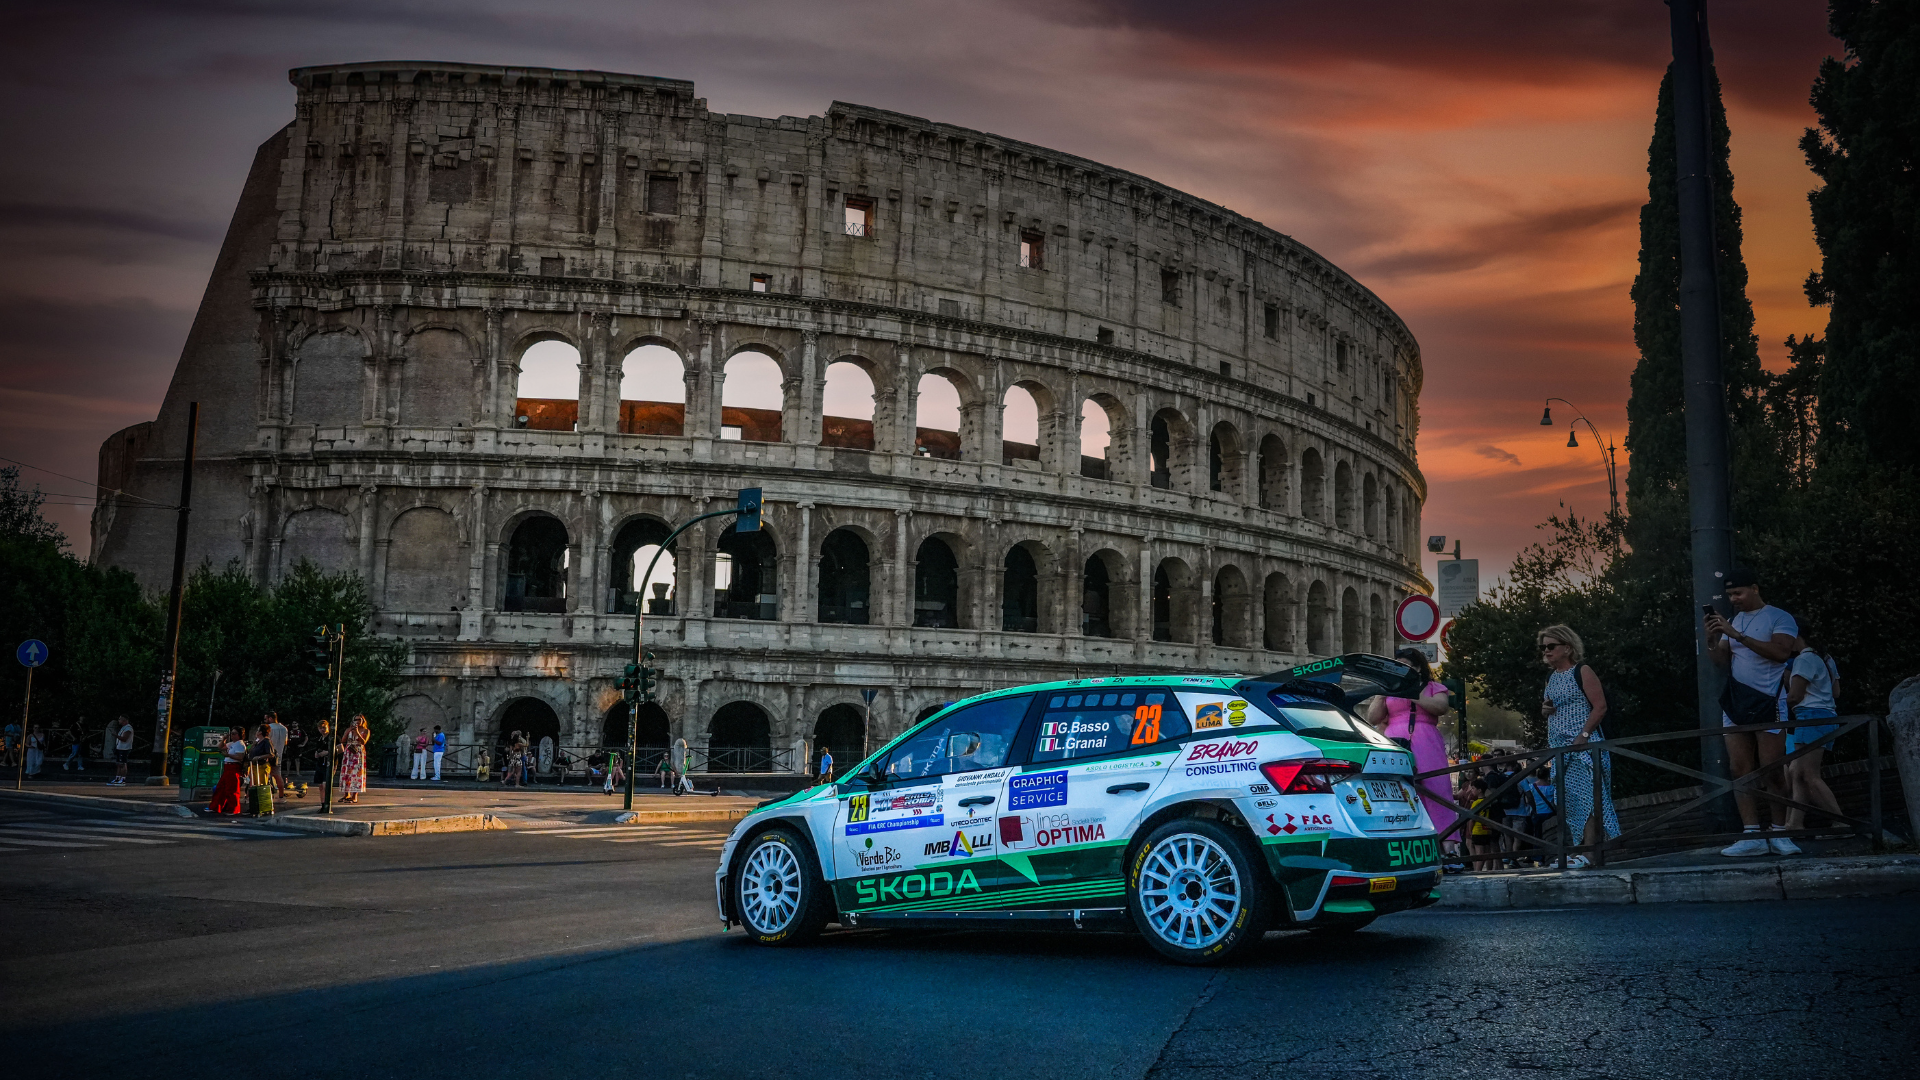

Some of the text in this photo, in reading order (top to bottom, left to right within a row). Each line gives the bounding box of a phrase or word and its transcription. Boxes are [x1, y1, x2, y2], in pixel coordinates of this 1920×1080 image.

[1058, 721, 1110, 734] G.Basso
[1131, 704, 1162, 745] 23
[1196, 719, 1222, 728] LUMA
[1054, 735, 1107, 750] L.Granai
[1187, 741, 1259, 761] BRANDO
[1185, 762, 1257, 776] CONSULTING
[1012, 774, 1064, 789] GRAPHIC
[1249, 785, 1270, 793] OMP
[1012, 791, 1064, 806] SERVICE
[850, 794, 867, 822] 23
[887, 819, 920, 828] Championship
[1036, 812, 1071, 829] linea
[1301, 814, 1333, 825] FAG
[1036, 823, 1105, 847] OPTIMA
[858, 846, 901, 866] Verde Bio
